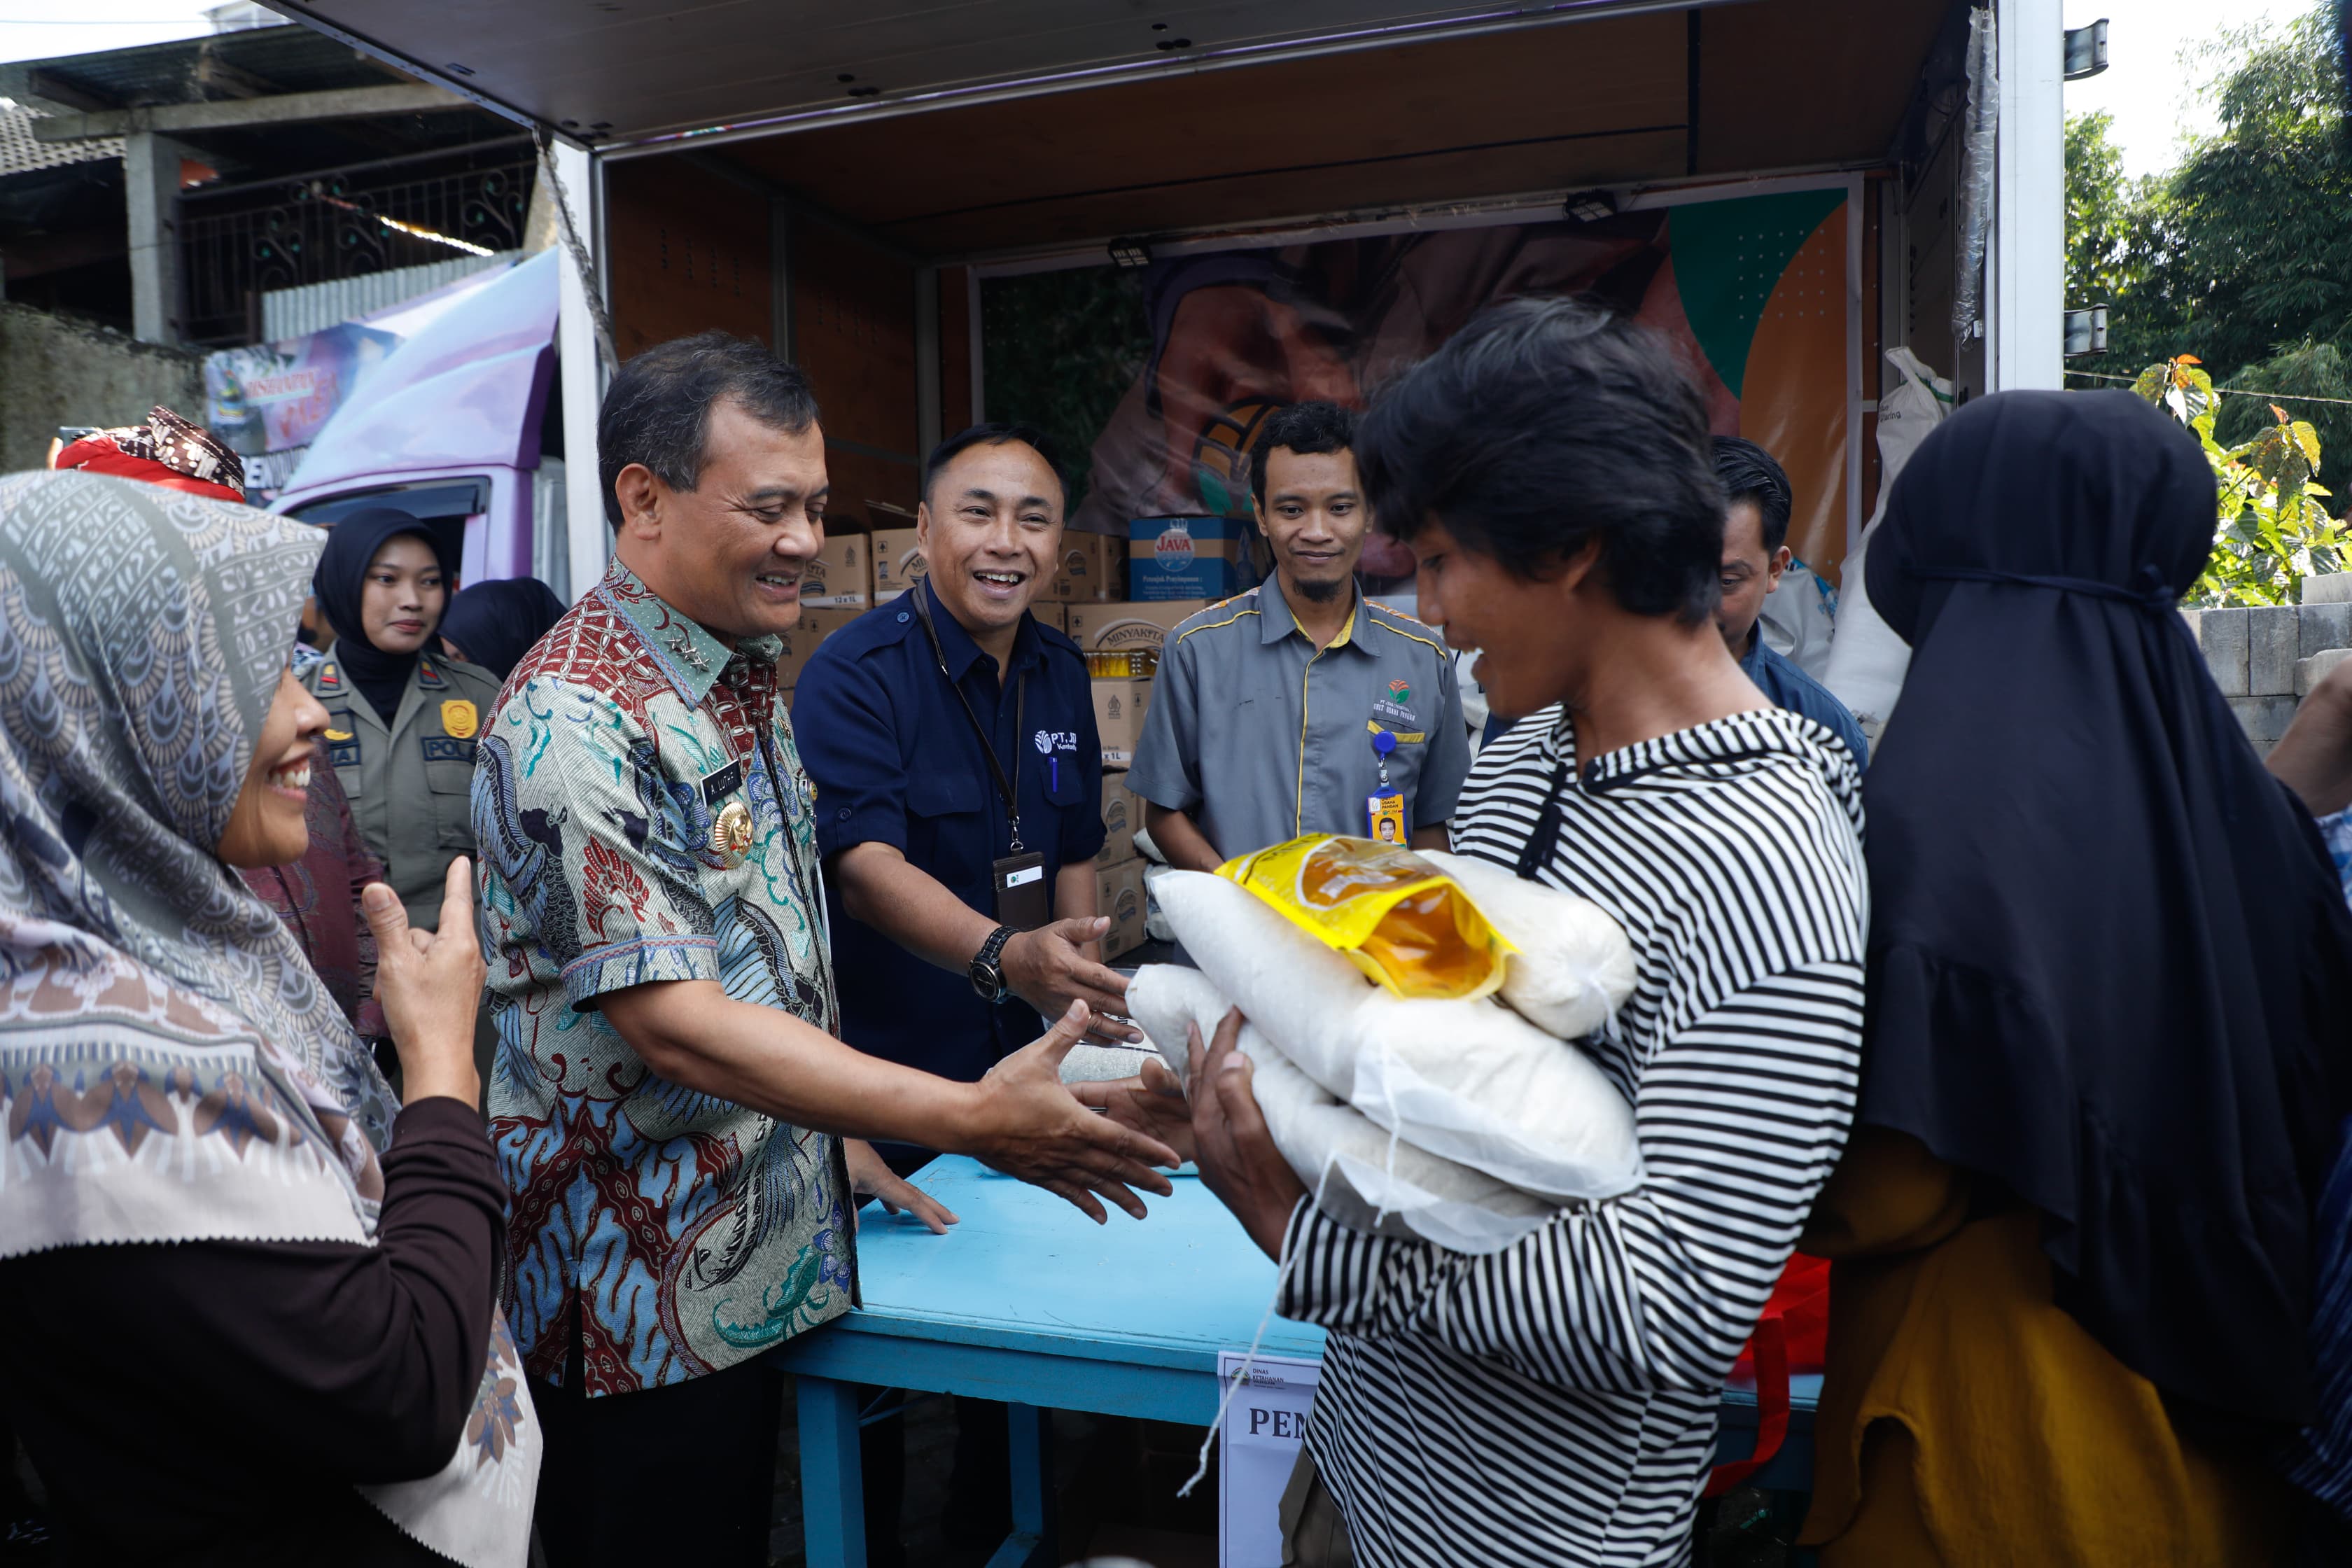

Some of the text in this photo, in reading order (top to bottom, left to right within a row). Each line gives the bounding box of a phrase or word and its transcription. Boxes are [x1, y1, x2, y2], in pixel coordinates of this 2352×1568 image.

[1156, 536, 1191, 552] JAVA
[1107, 627, 1165, 646] MINYAKITA
[1373, 703, 1416, 722] UNIT USAHA PANGAN
